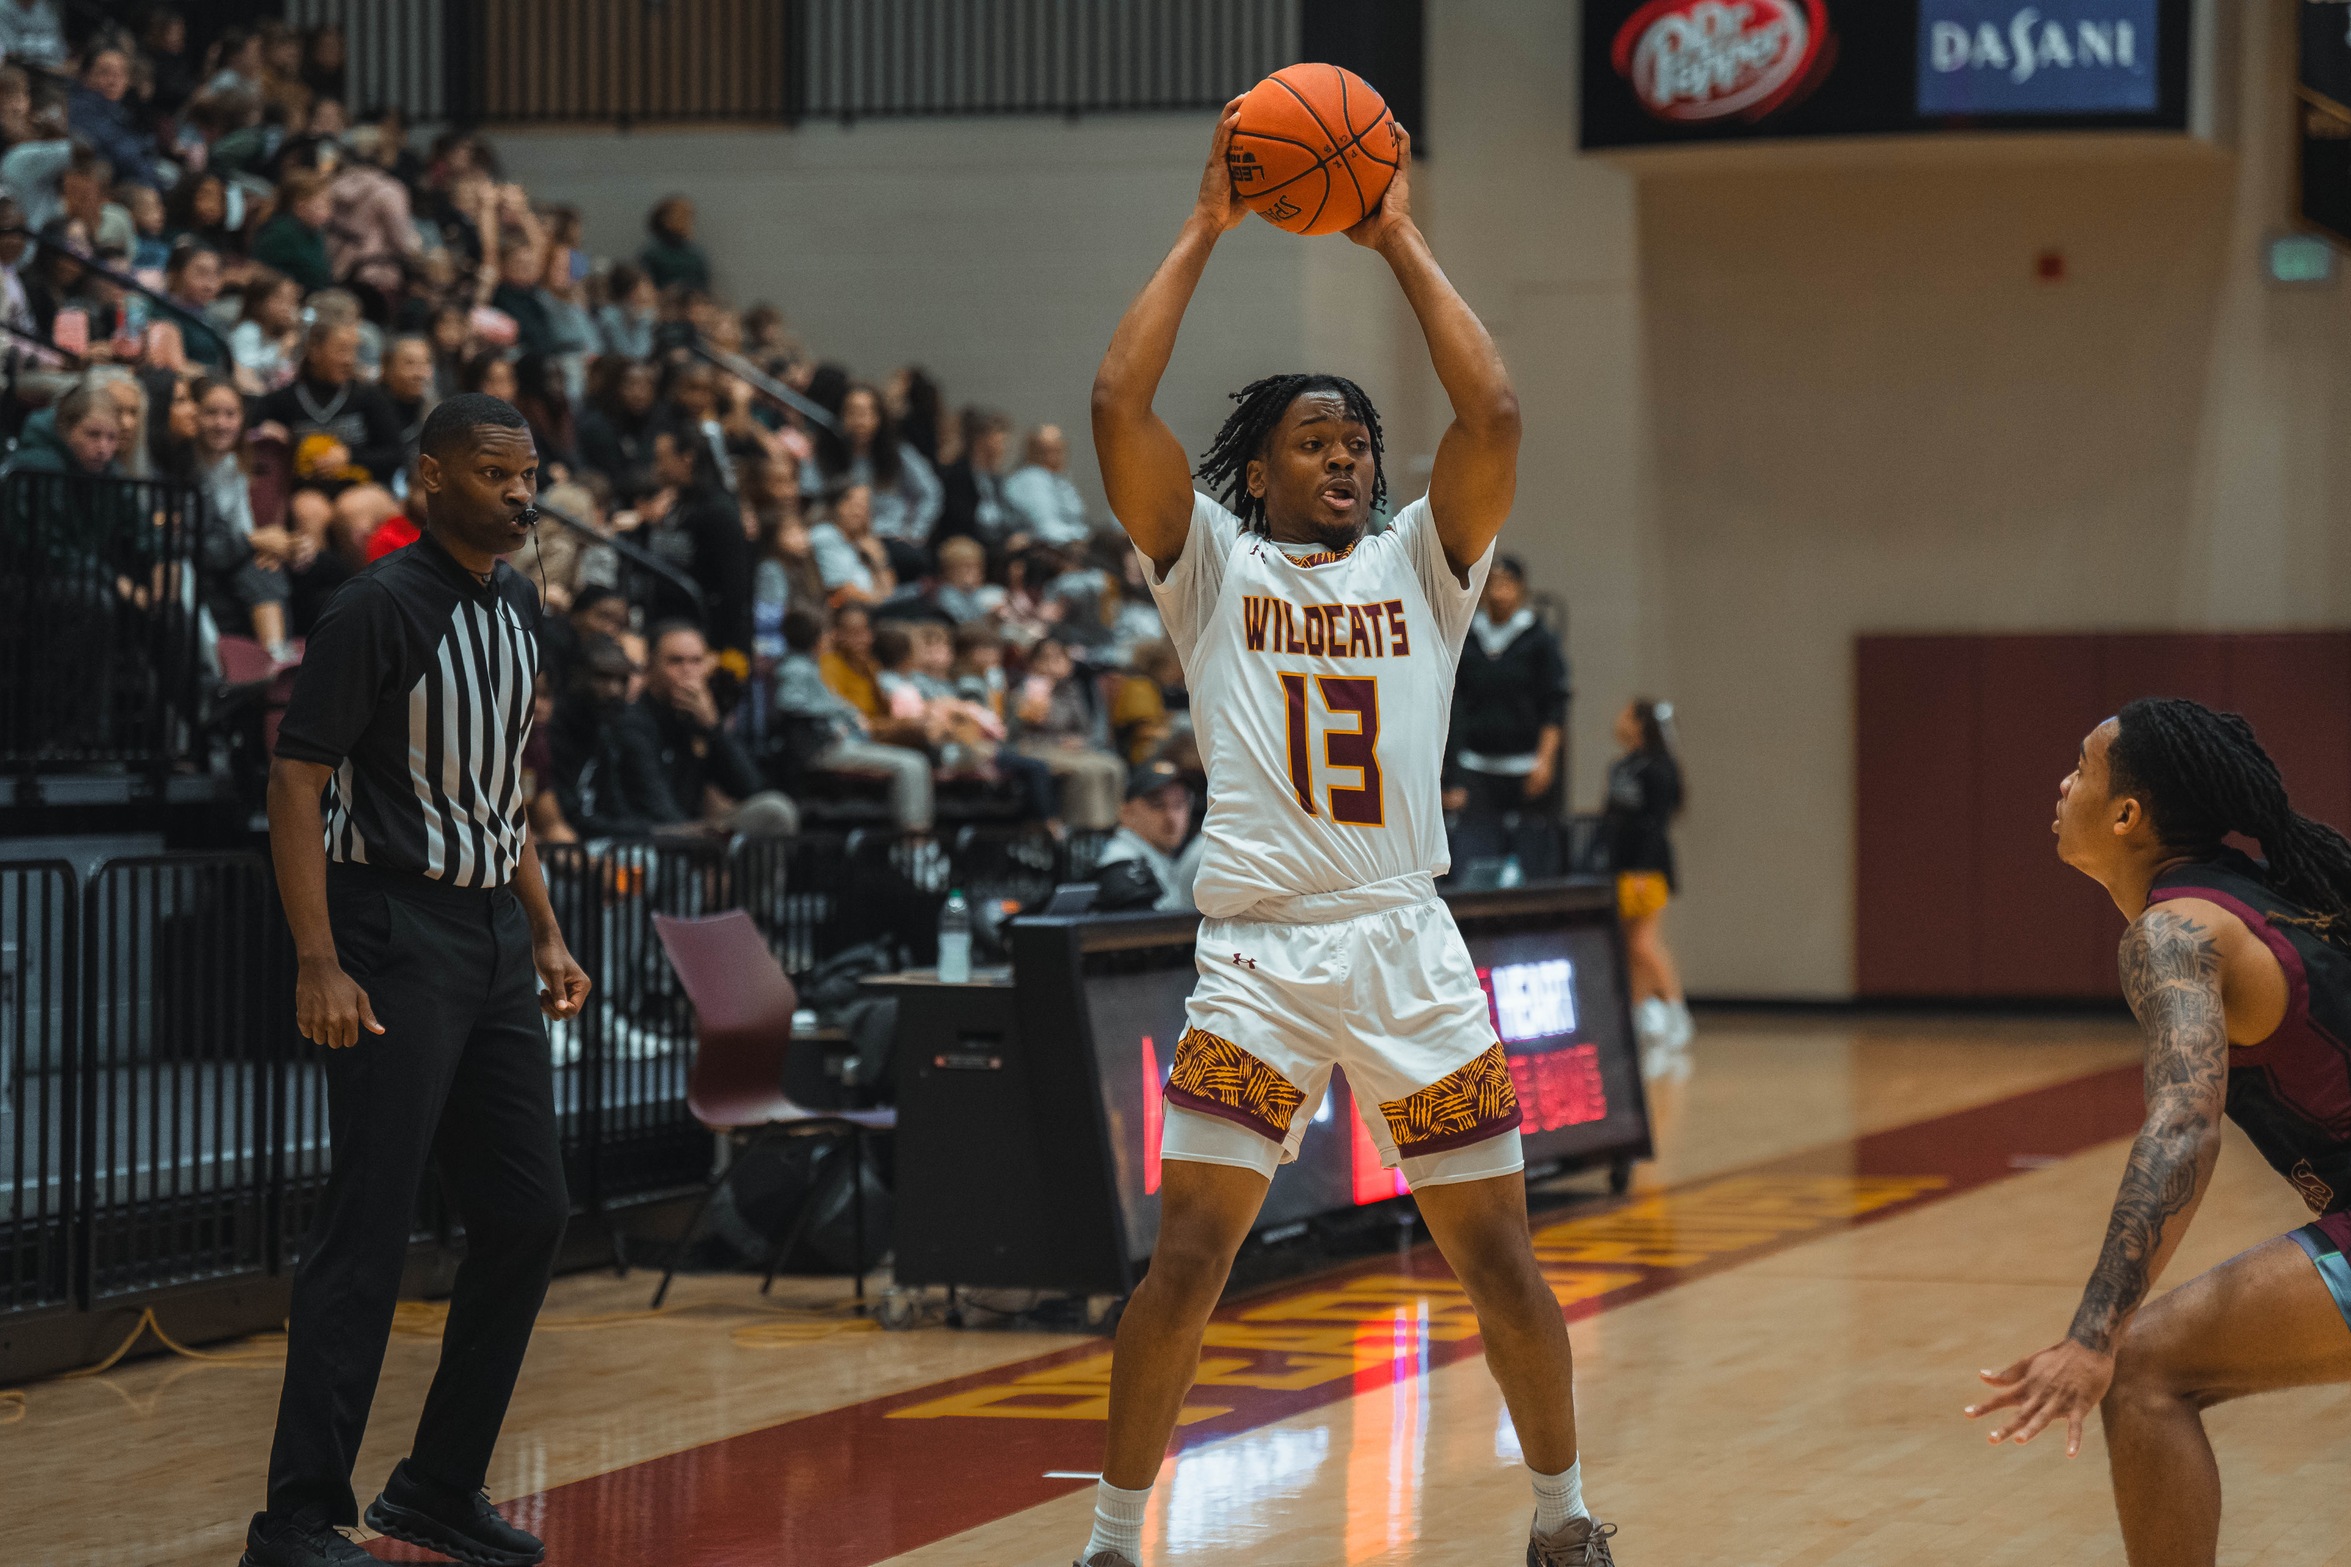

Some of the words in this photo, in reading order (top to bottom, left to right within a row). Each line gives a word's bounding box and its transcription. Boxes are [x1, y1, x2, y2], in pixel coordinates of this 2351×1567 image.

[1931, 6, 2136, 84] DASANI
[1242, 595, 1410, 658] WILDCATS
[1277, 671, 1385, 828] 13
